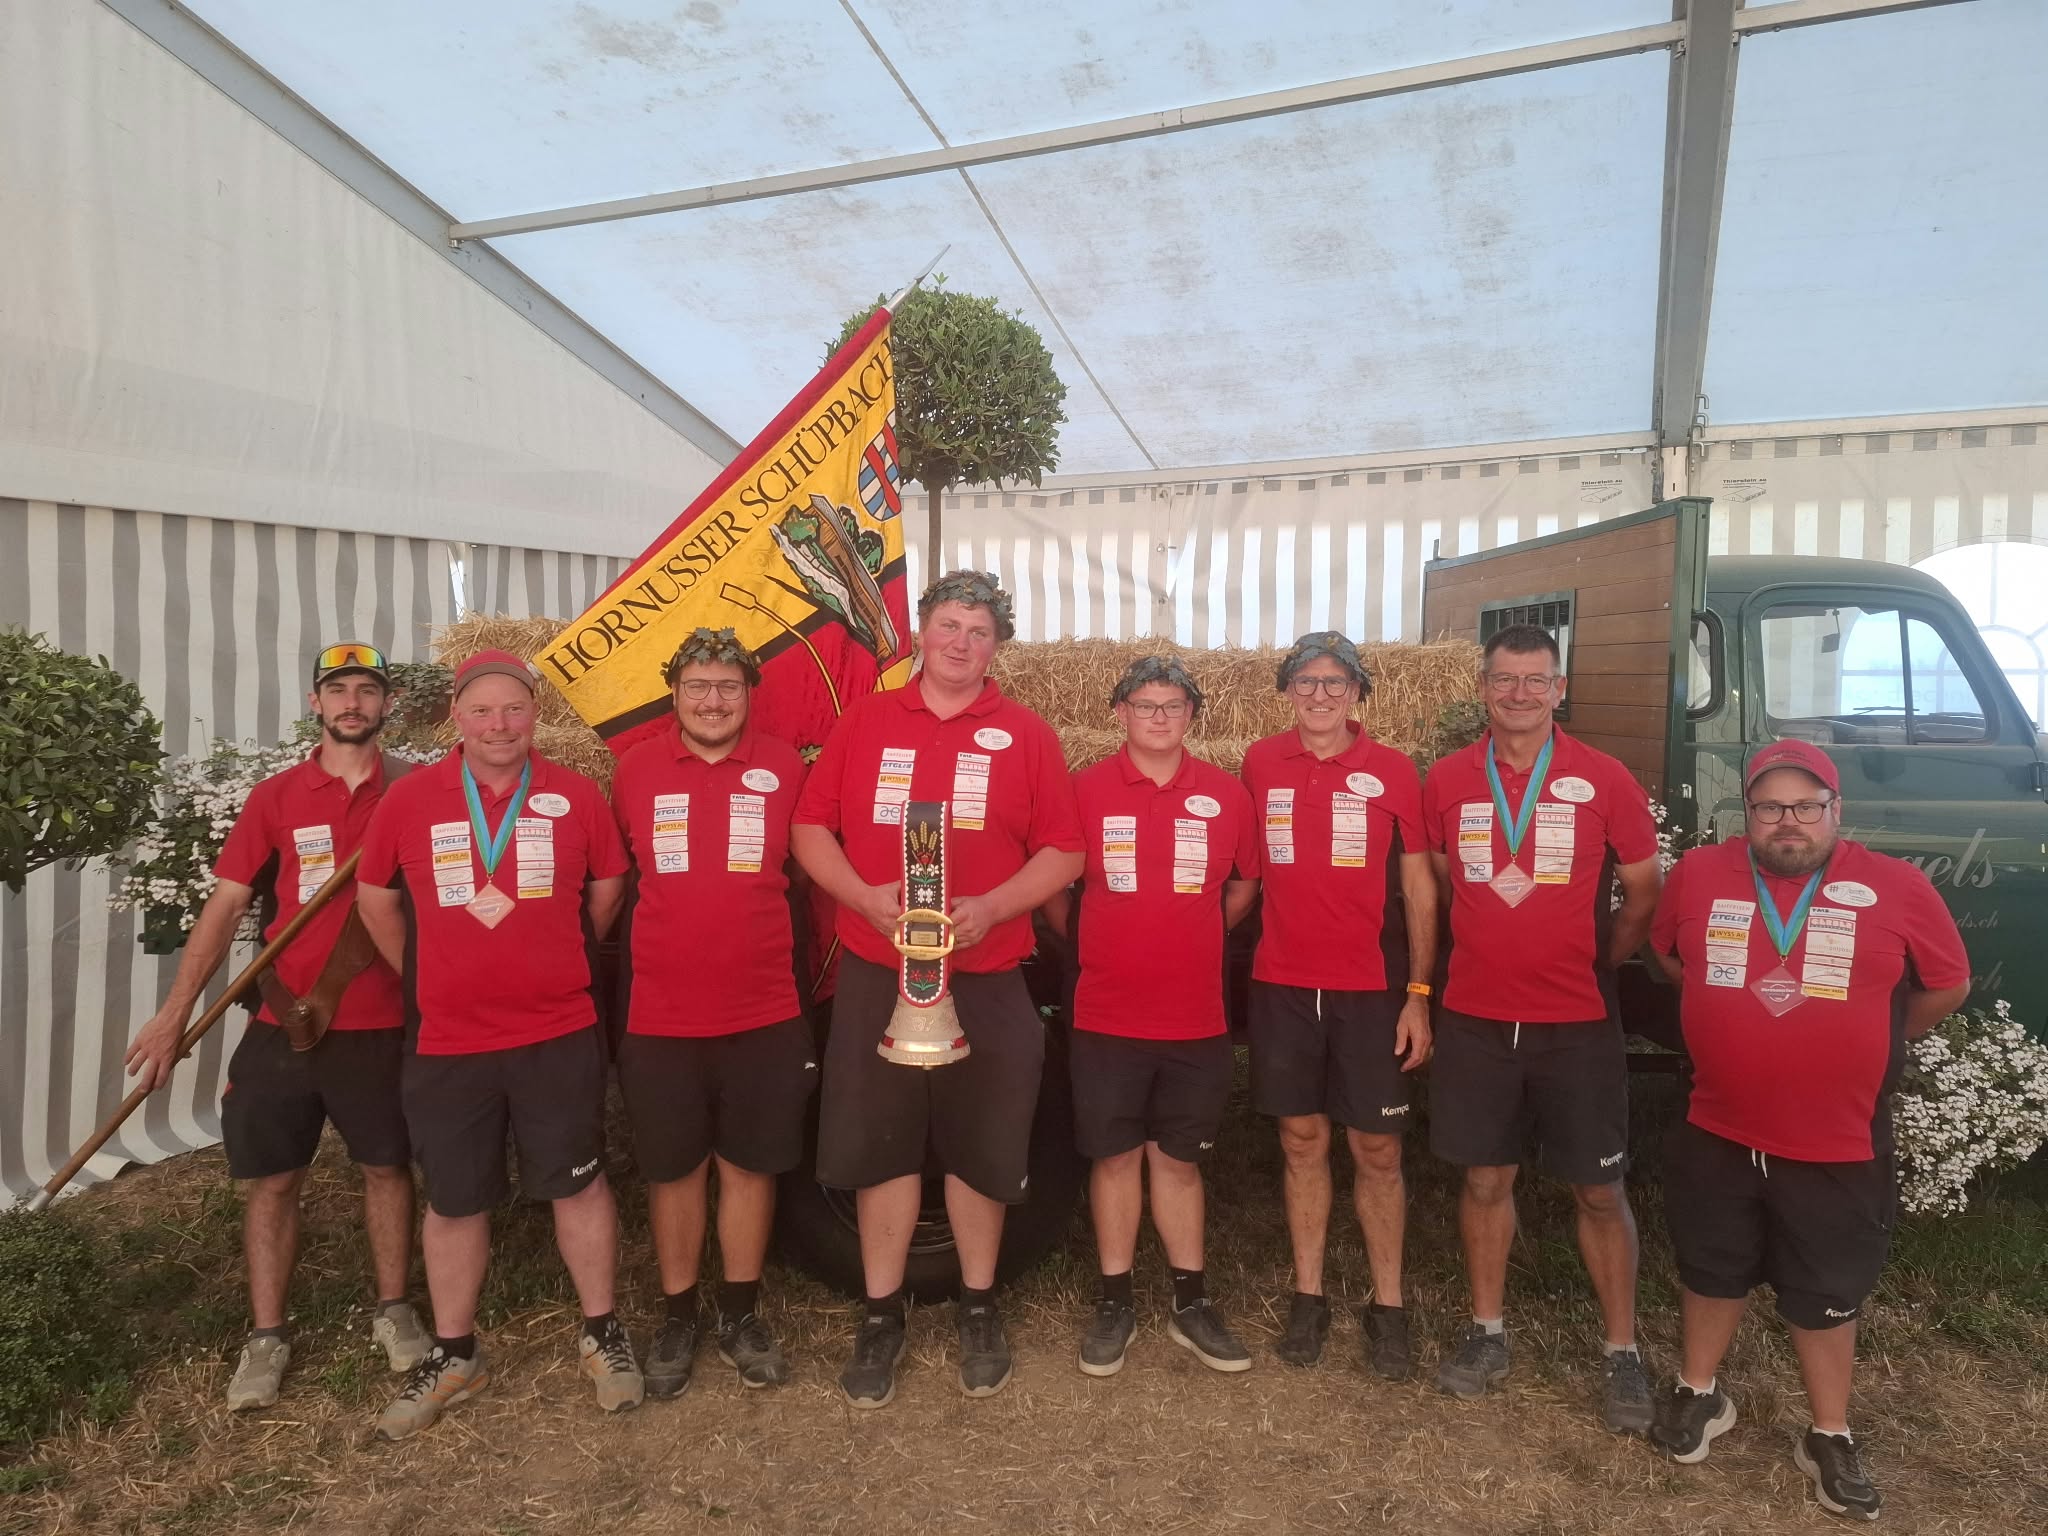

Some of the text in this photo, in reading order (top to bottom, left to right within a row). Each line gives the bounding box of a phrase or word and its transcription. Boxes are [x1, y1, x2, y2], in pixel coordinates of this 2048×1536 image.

[544, 337, 894, 685] HORNUSSER SCHÜPBACH
[1381, 1104, 1410, 1117] Kempa
[572, 1157, 598, 1177] Kempa
[1600, 1151, 1623, 1168] Kempa
